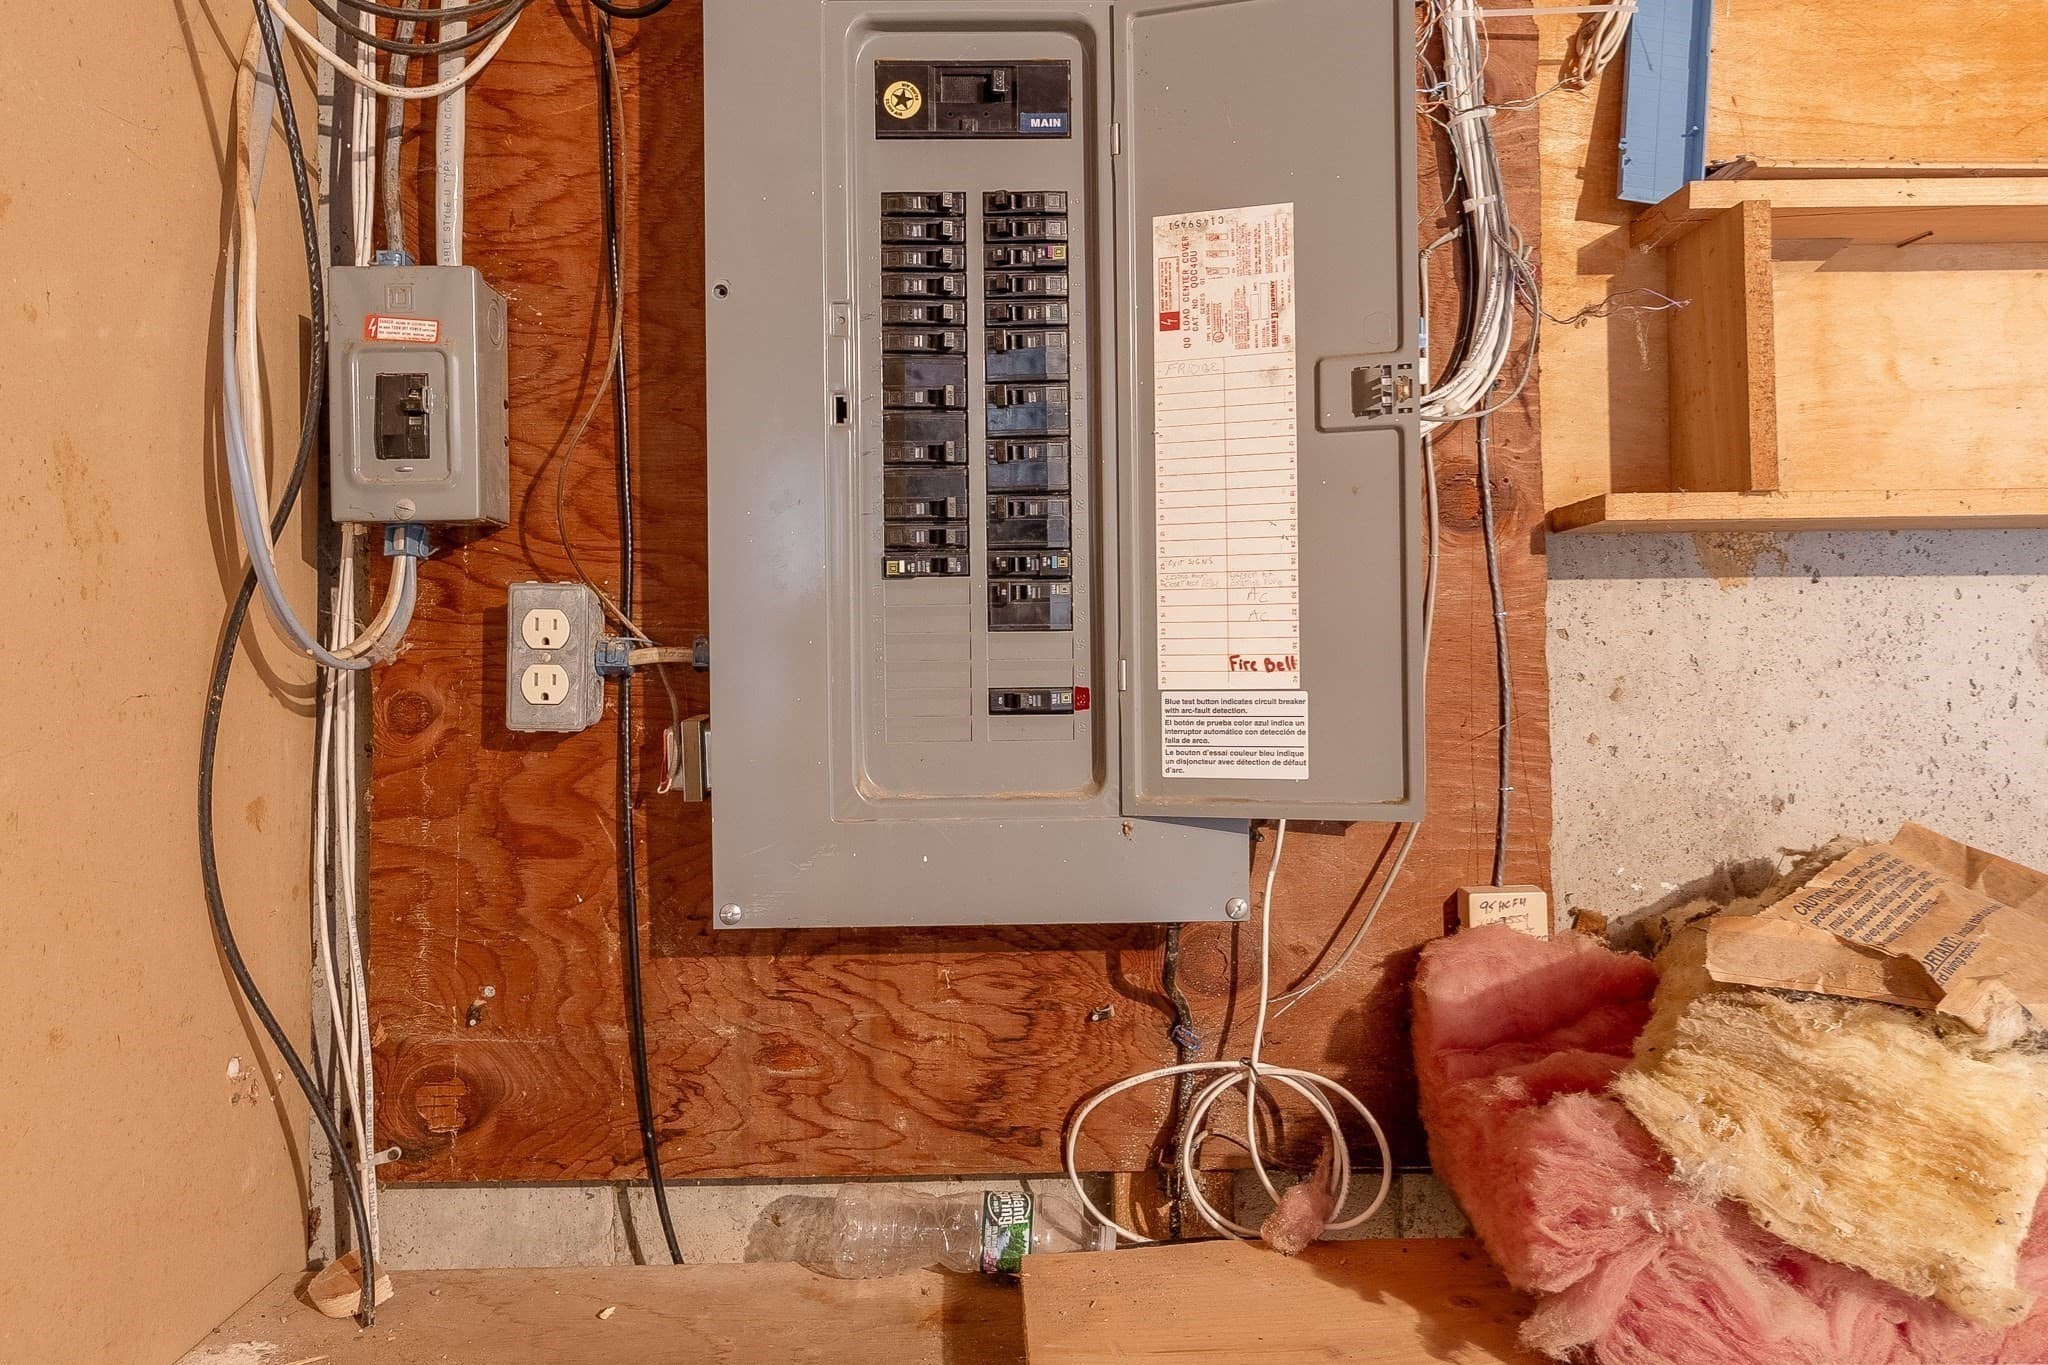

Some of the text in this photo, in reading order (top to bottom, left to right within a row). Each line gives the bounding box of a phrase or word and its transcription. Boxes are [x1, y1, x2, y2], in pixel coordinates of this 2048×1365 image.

[1030, 118, 1061, 128] MAIN
[443, 200, 451, 232] STYLE
[1181, 235, 1190, 264] COVER
[1182, 269, 1190, 303] CENTER
[1183, 308, 1191, 332] LOAD
[1192, 316, 1200, 332] CAT
[1229, 655, 1258, 672] Fire
[1207, 719, 1232, 727] prueba
[1165, 728, 1202, 736] interruptor
[1260, 728, 1295, 736] detección
[1297, 728, 1306, 736] de
[1229, 749, 1257, 757] couleur
[1259, 749, 1275, 757] bleu
[1276, 749, 1304, 758] indique
[1176, 758, 1216, 766] disjoncteur
[1236, 758, 1270, 766] détection
[1272, 758, 1281, 766] de
[1282, 758, 1307, 766] défaut
[1935, 971, 1949, 986] rd
